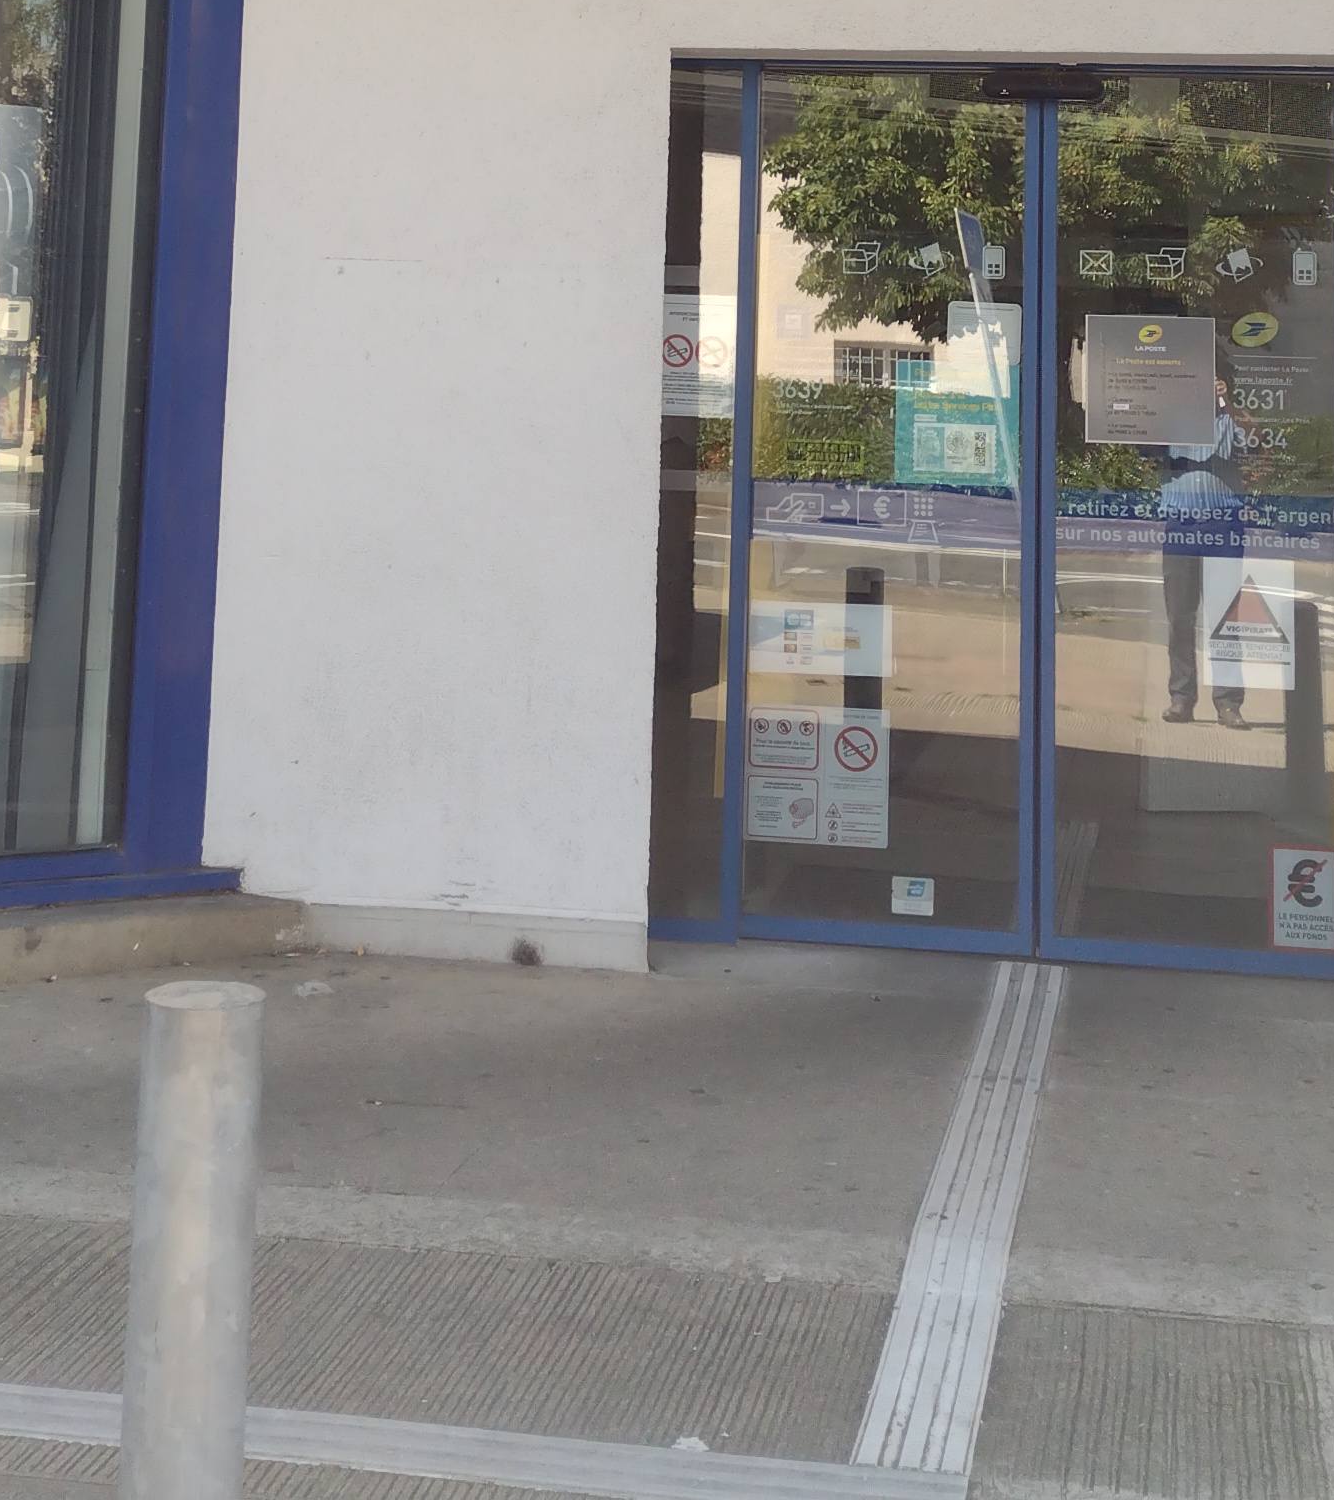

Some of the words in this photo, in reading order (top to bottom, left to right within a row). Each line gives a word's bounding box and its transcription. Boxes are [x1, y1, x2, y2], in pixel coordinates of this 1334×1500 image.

[773, 377, 823, 400] 3639
[1233, 426, 1288, 449] 3634
[1068, 499, 1129, 518] retirez
[1134, 502, 1153, 519] et
[1238, 504, 1260, 522] de
[1055, 525, 1085, 541] sur
[1090, 527, 1123, 543] nos
[1127, 528, 1225, 547] automates
[1229, 530, 1321, 550] bancaires
[1225, 625, 1273, 634] VIGIPIRATE
[1216, 649, 1244, 658] RISQUE
[1246, 650, 1283, 660] ATTENTAT
[1278, 912, 1288, 920] LE
[1289, 913, 1334, 923] PERSONNEL
[1293, 922, 1307, 930] PAS
[1285, 930, 1301, 939] AUX
[1302, 932, 1328, 941] FONDS
